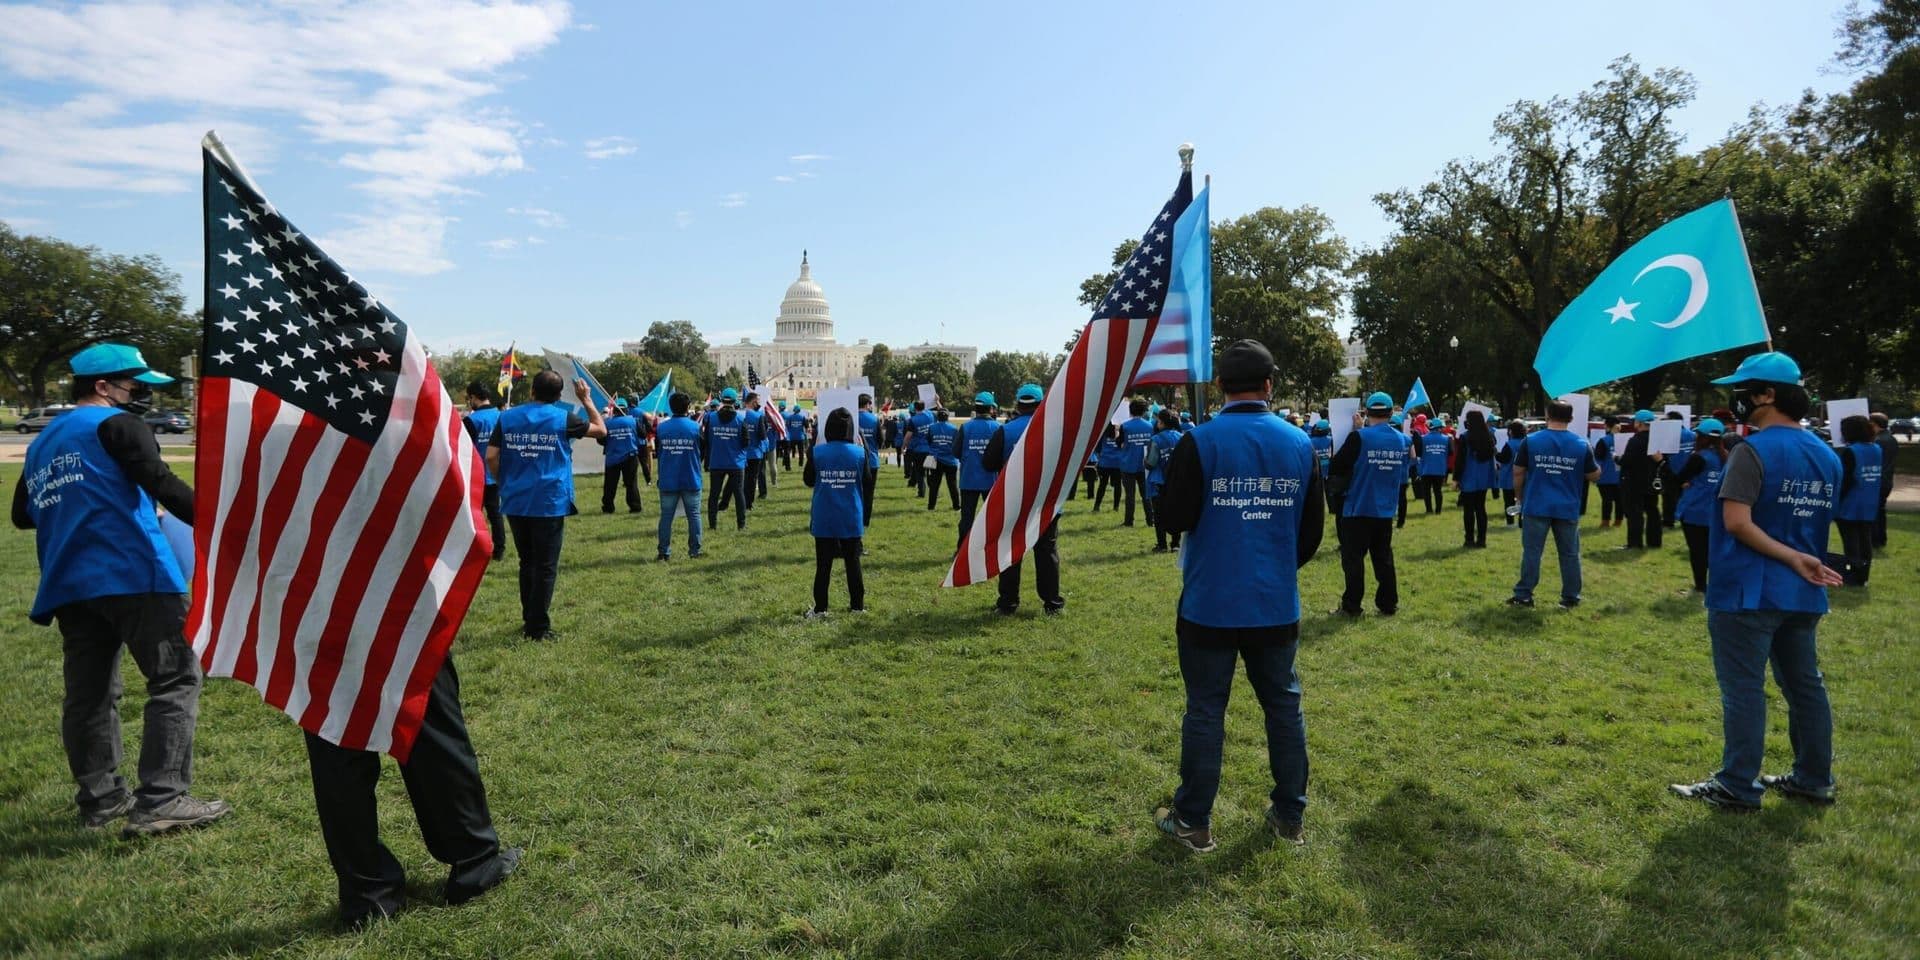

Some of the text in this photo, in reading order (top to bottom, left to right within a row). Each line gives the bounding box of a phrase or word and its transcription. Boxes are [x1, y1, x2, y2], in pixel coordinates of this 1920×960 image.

[1212, 477, 1300, 494] 喀什市看守所
[1212, 496, 1294, 509] Kashgar Detenti
[1241, 510, 1273, 520] Center
